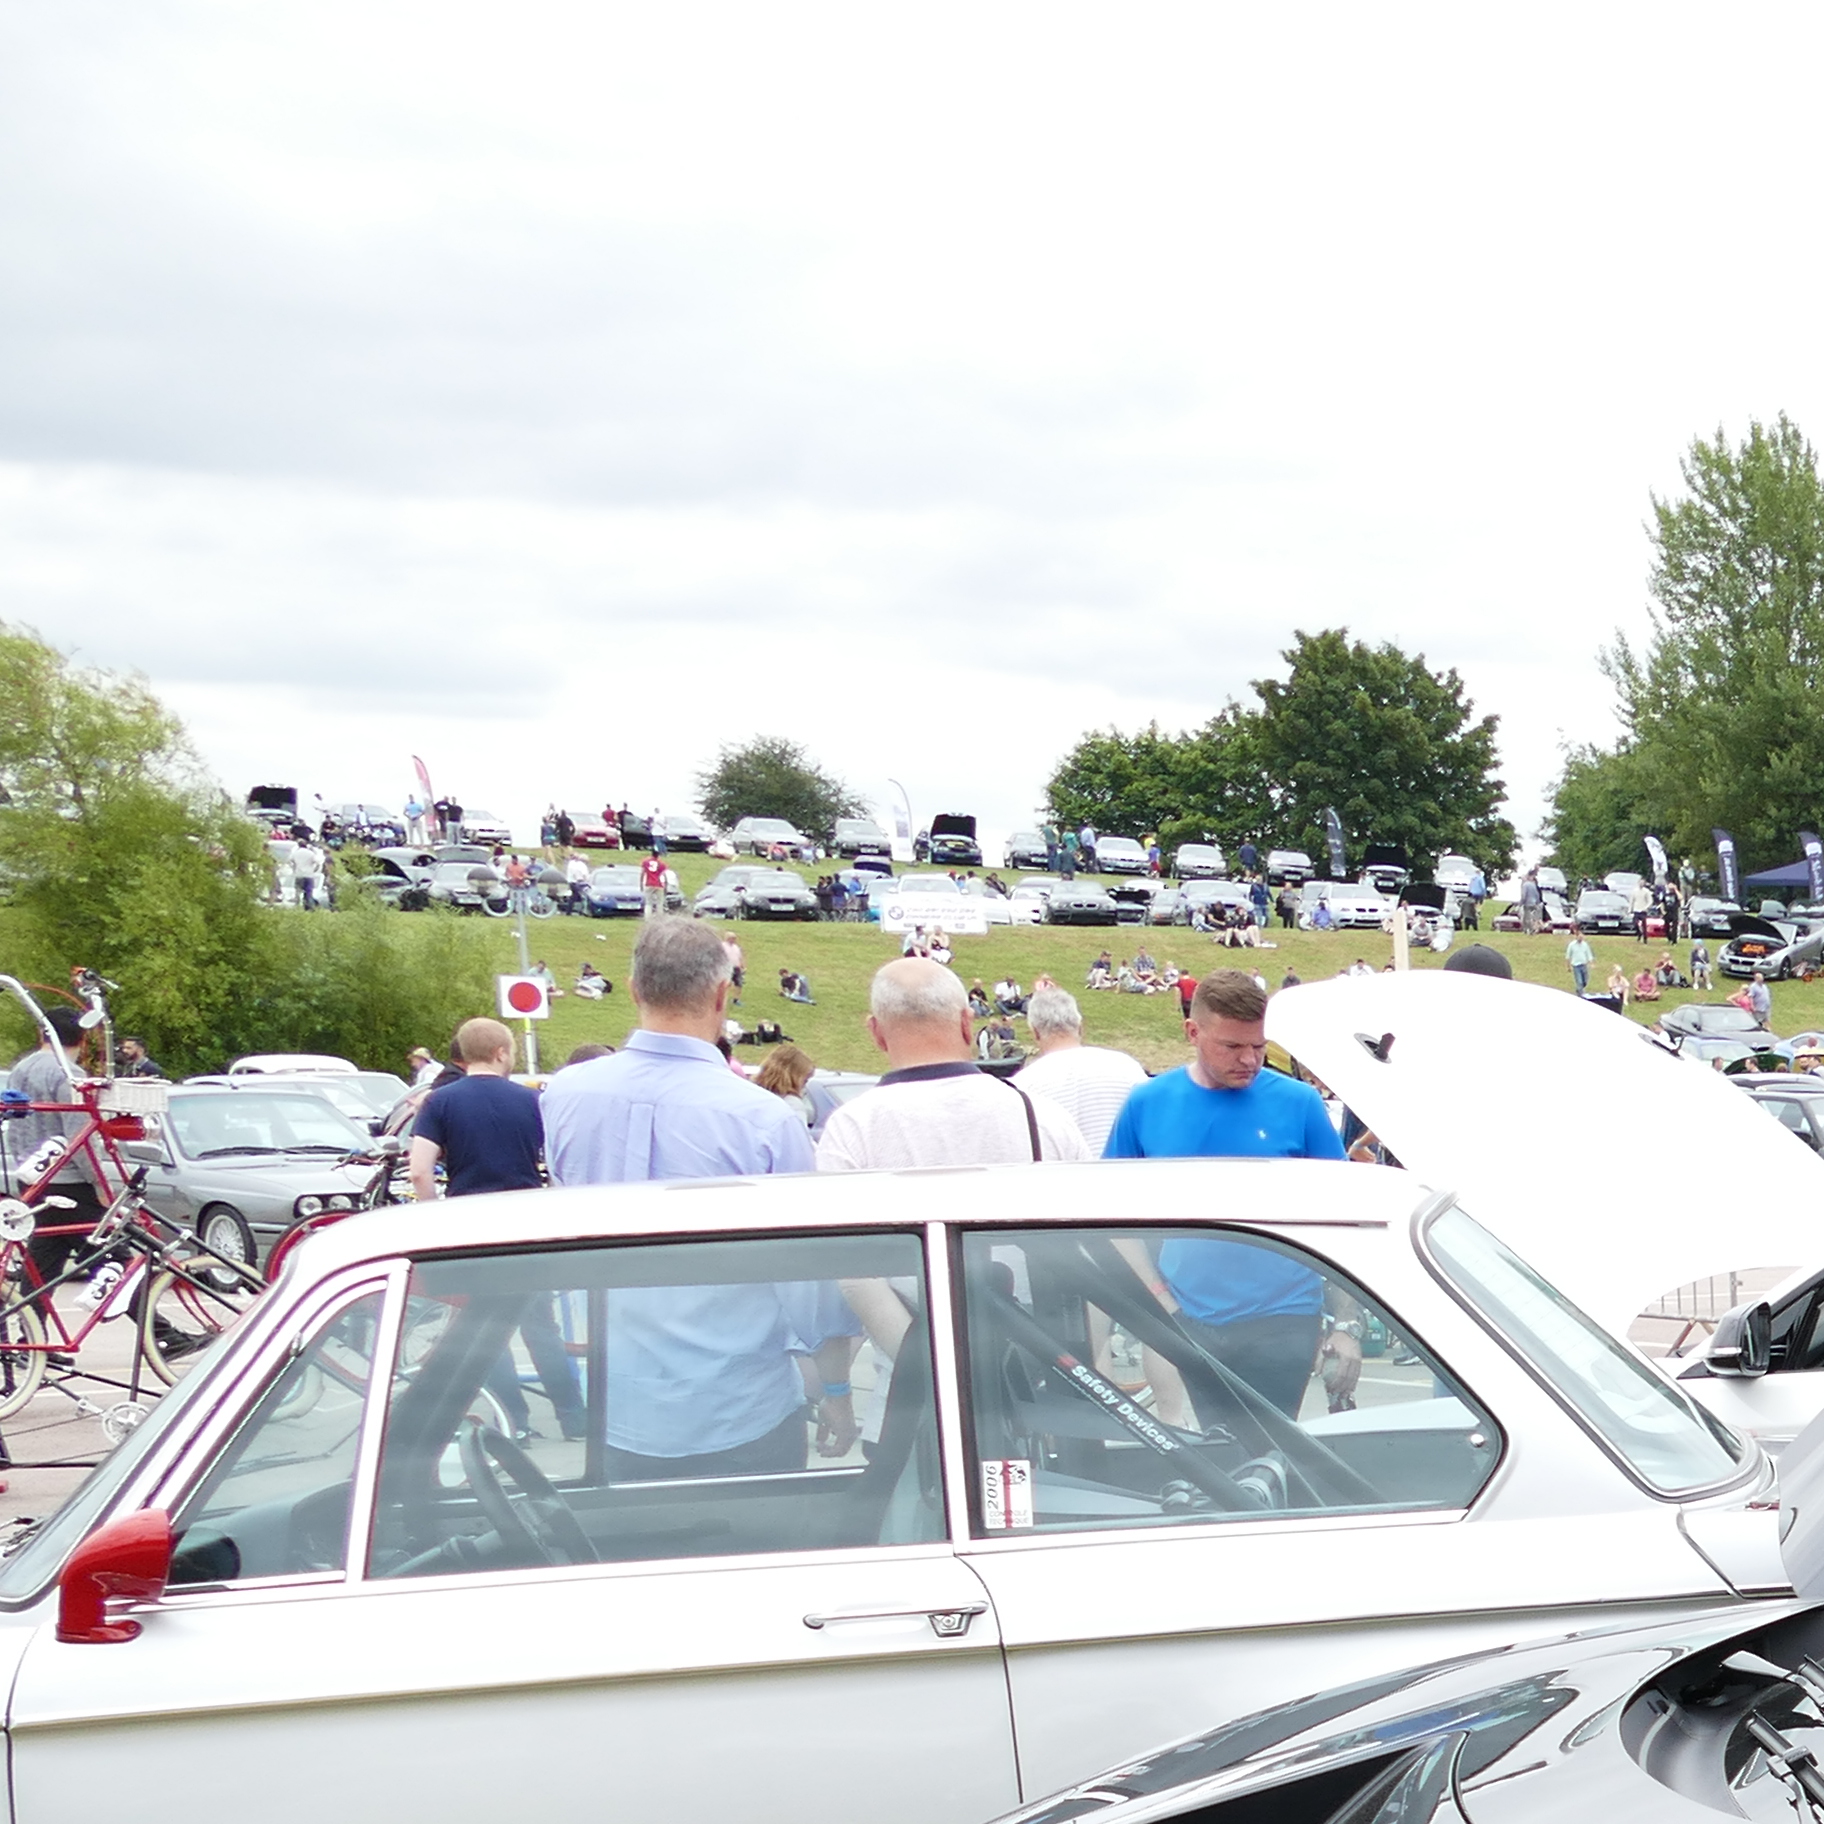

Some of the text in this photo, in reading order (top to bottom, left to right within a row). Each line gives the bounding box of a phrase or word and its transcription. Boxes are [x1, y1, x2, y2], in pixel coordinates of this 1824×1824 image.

[1072, 1365, 1119, 1405] Safety
[1117, 1403, 1174, 1451] Devices
[985, 1465, 999, 1510] 2006
